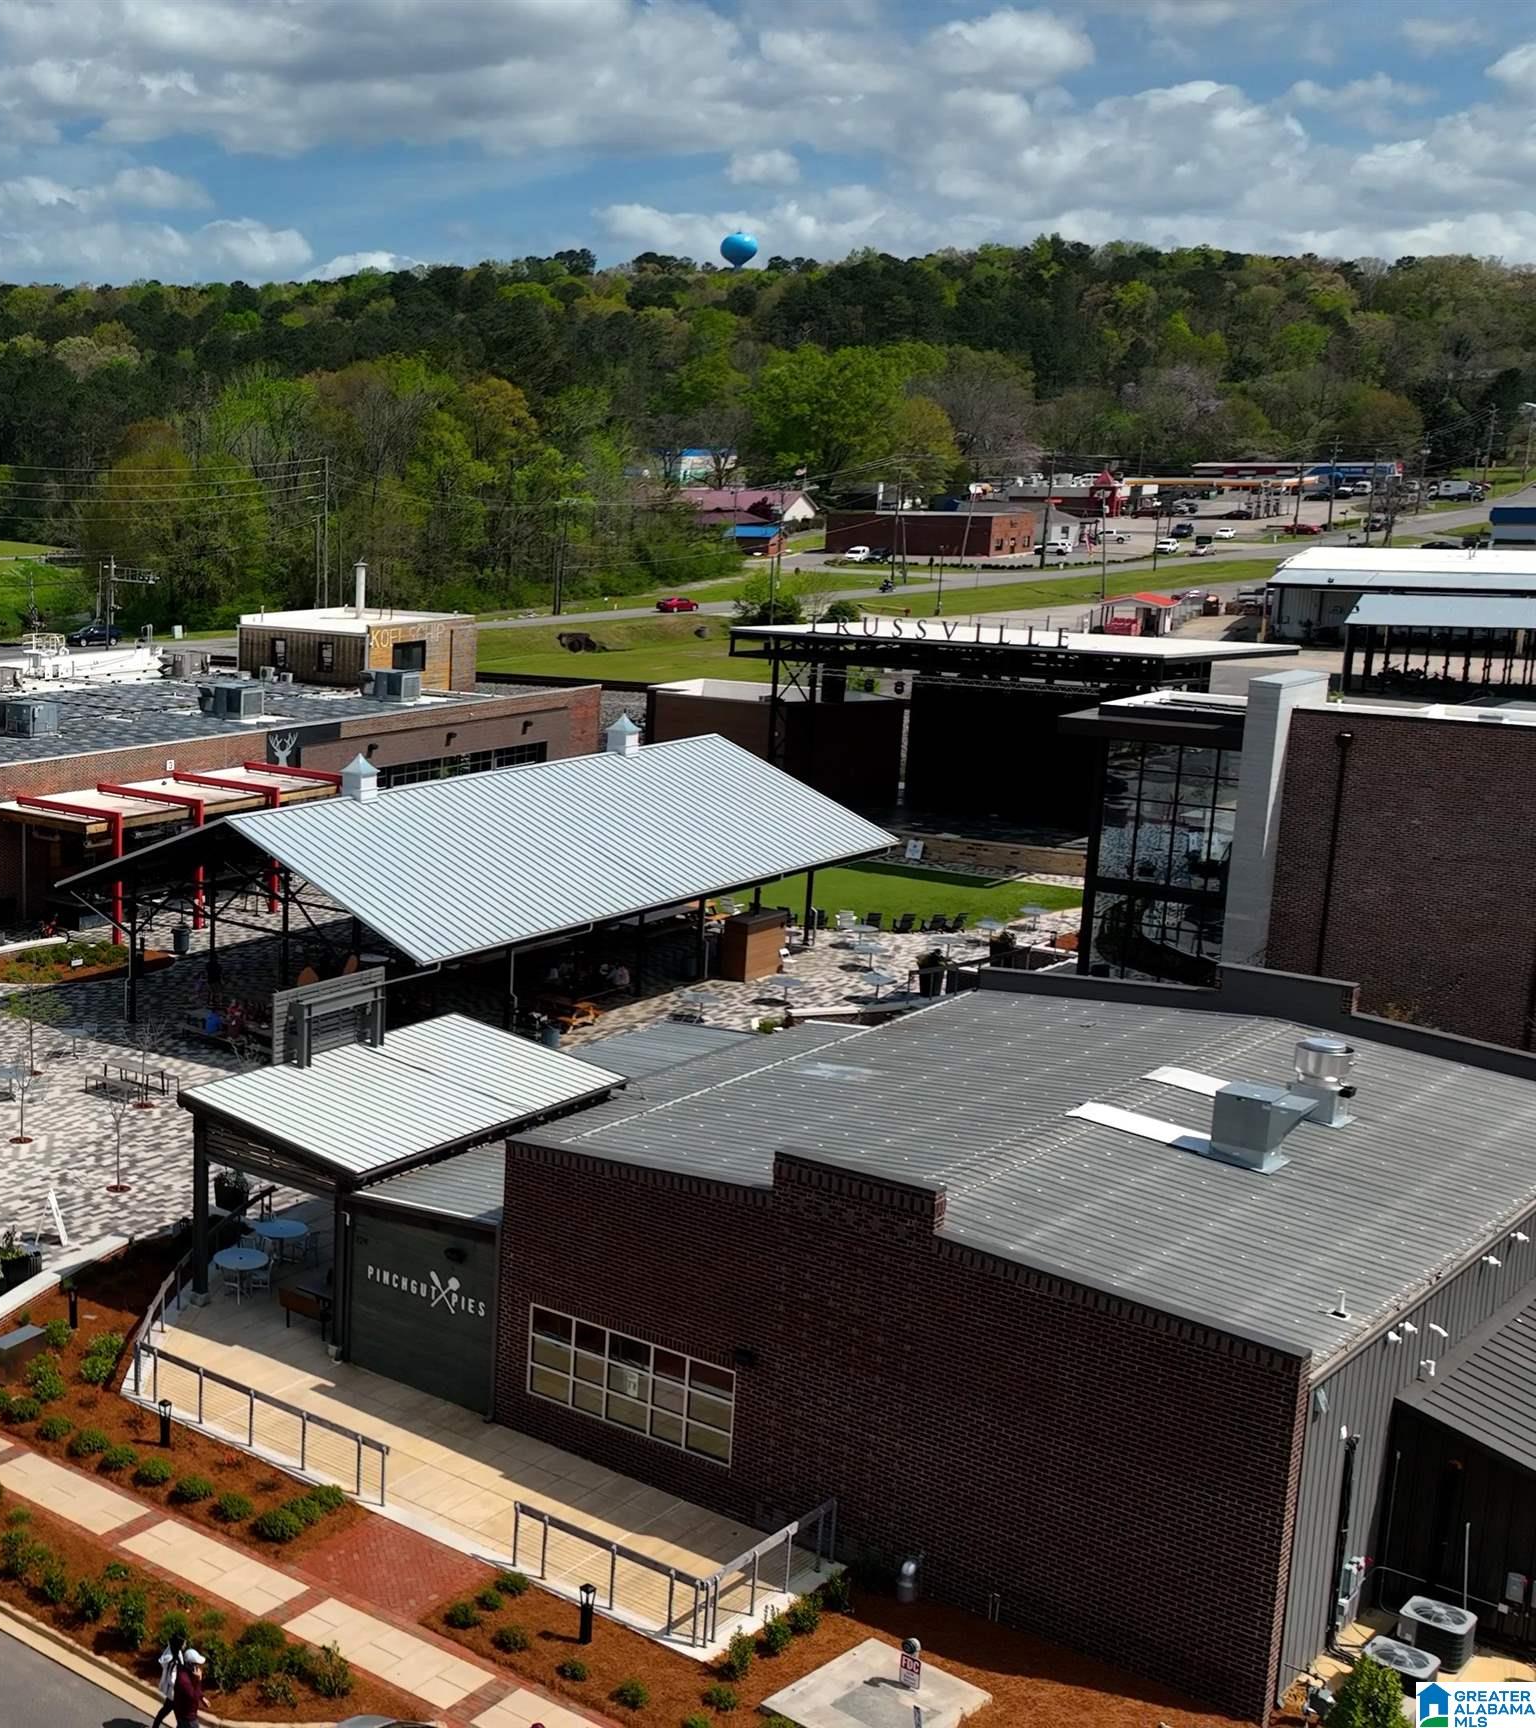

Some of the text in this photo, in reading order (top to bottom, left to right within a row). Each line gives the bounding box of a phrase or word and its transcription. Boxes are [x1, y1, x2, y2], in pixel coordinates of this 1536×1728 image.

[806, 614, 1070, 648] TRUSSVILLE
[367, 1265, 485, 1317] PINCHGUT PIES
[902, 1656, 920, 1673] FDC
